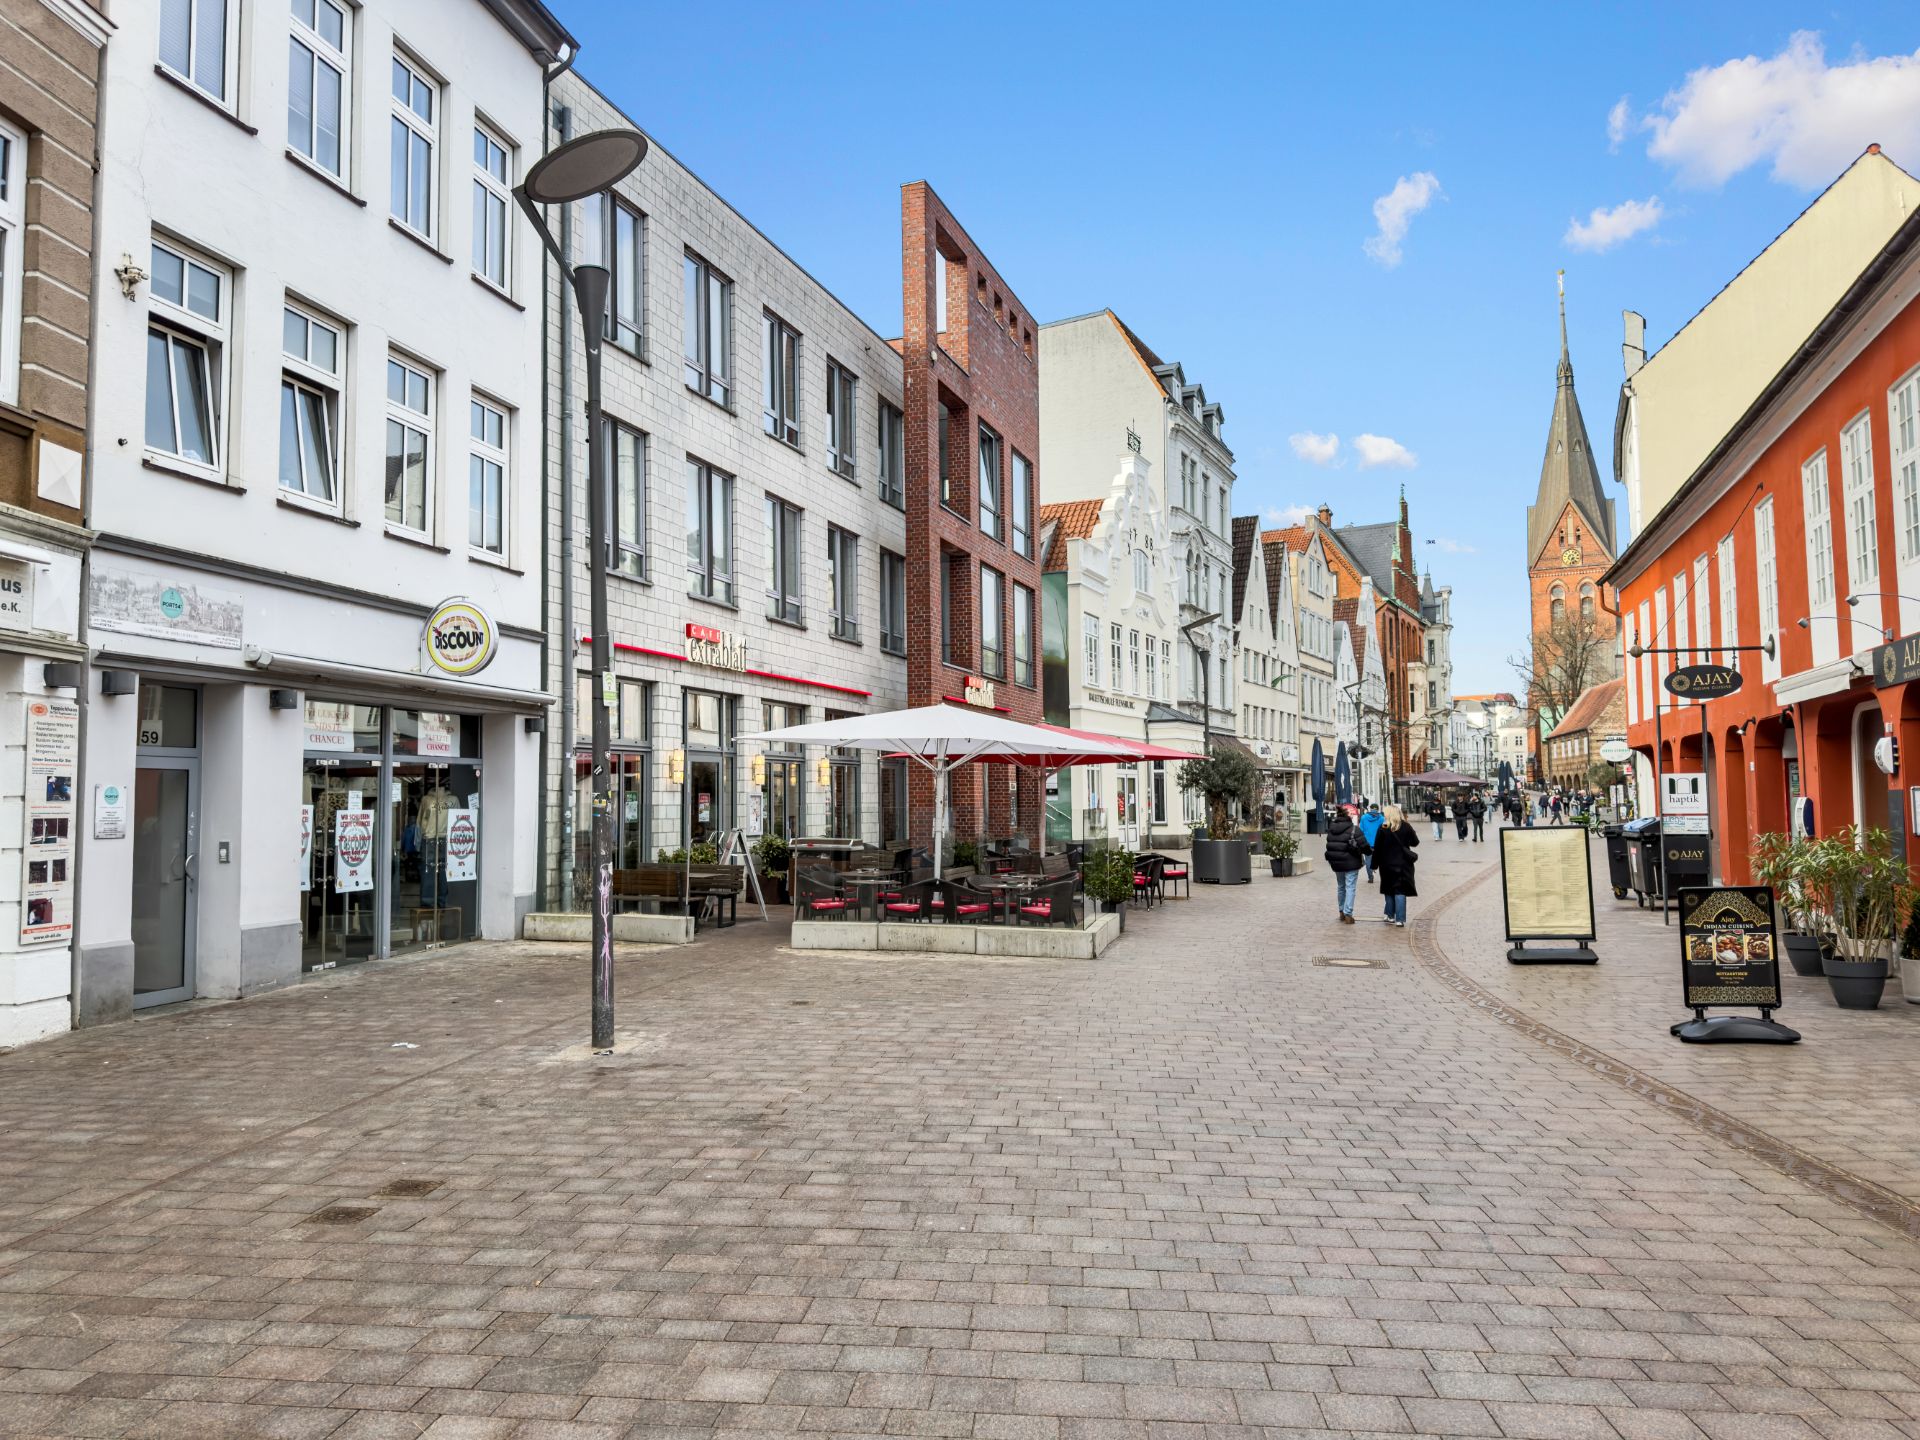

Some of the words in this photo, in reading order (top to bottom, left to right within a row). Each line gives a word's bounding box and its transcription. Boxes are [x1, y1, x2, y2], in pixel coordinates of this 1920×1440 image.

[1, 578, 22, 594] us
[1, 601, 21, 613] e.K.
[690, 631, 747, 671] extrablatt
[1693, 671, 1734, 686] AJAY
[140, 730, 159, 744] 59
[309, 734, 345, 745] CHANCE!
[1669, 794, 1700, 805] haptik
[1680, 850, 1705, 858] AJAY
[1721, 915, 1736, 923] Ajay
